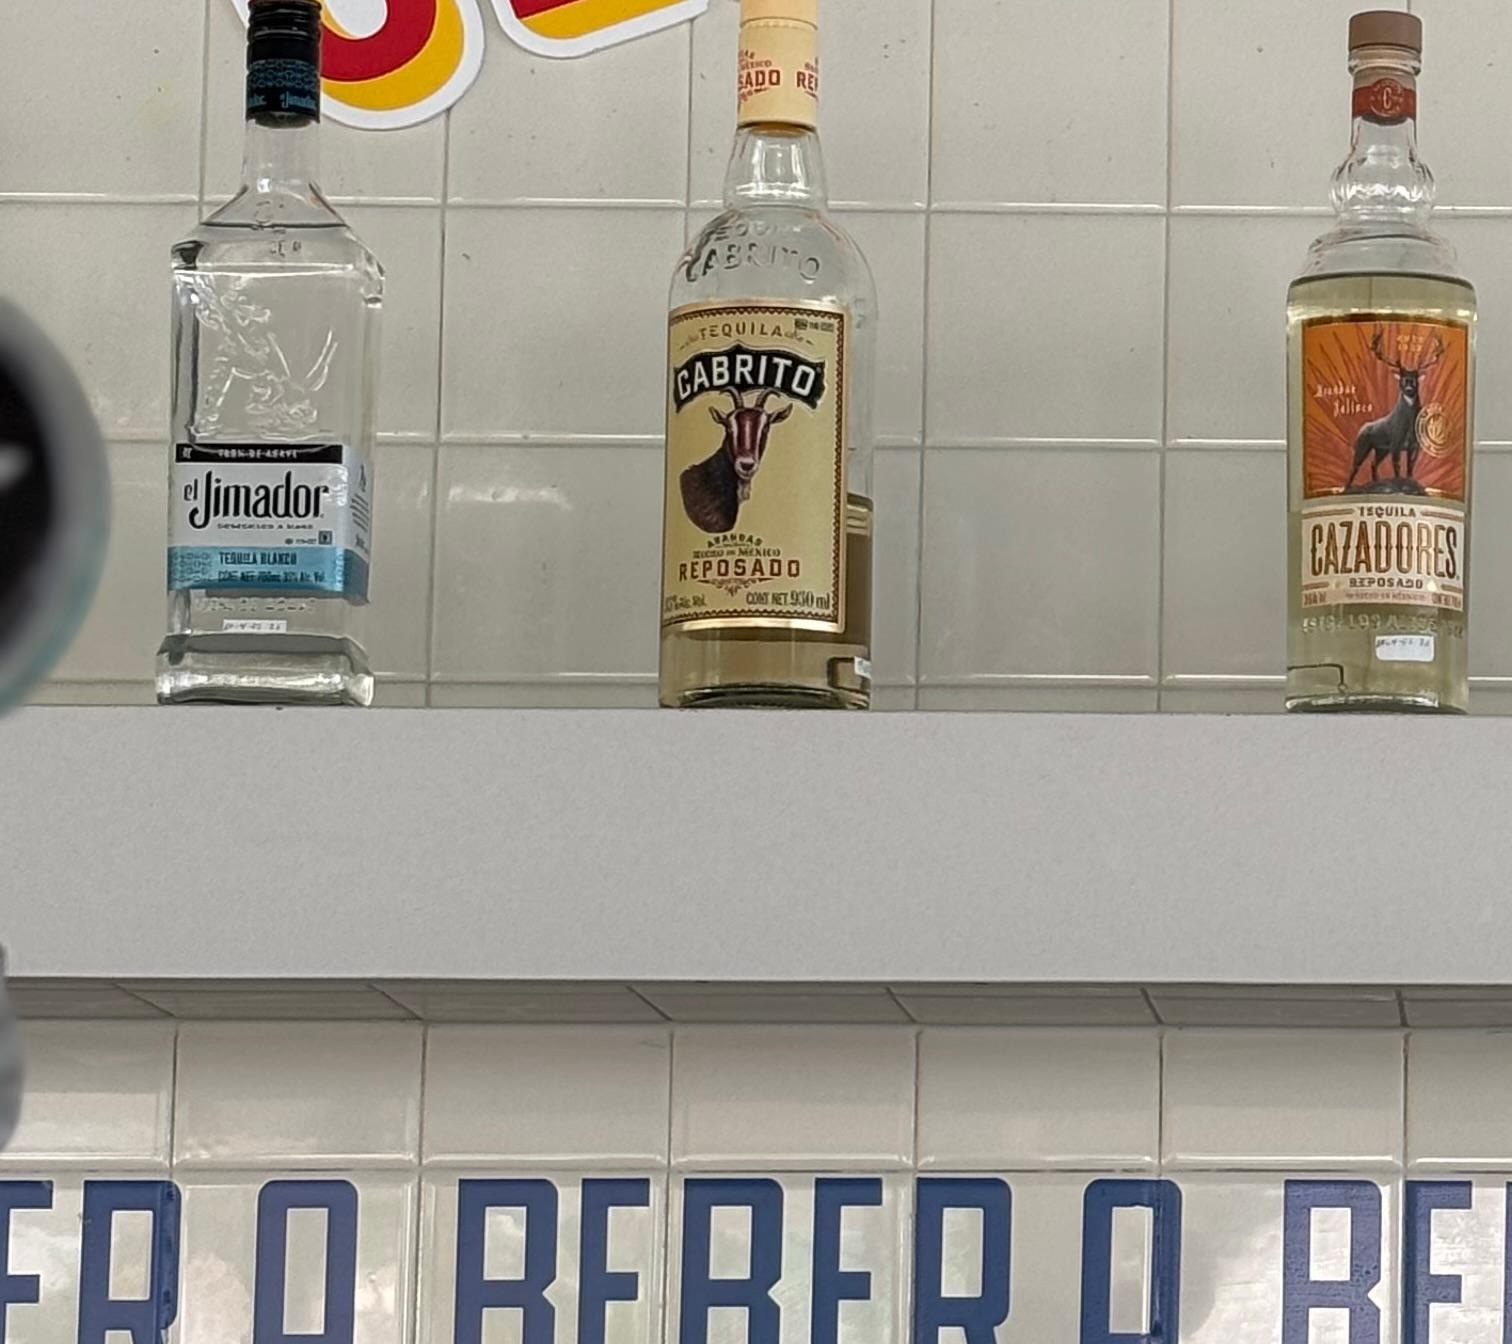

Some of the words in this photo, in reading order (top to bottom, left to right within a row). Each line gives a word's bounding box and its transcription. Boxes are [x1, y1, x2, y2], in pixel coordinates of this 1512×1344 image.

[698, 320, 782, 340] TEQUILA
[676, 354, 816, 401] CABRITO
[183, 478, 198, 502] el
[188, 470, 330, 529] Jimador
[1311, 520, 1457, 580] CAZADORES
[679, 558, 800, 582] REPOSADO
[1349, 577, 1424, 590] REPOSADO
